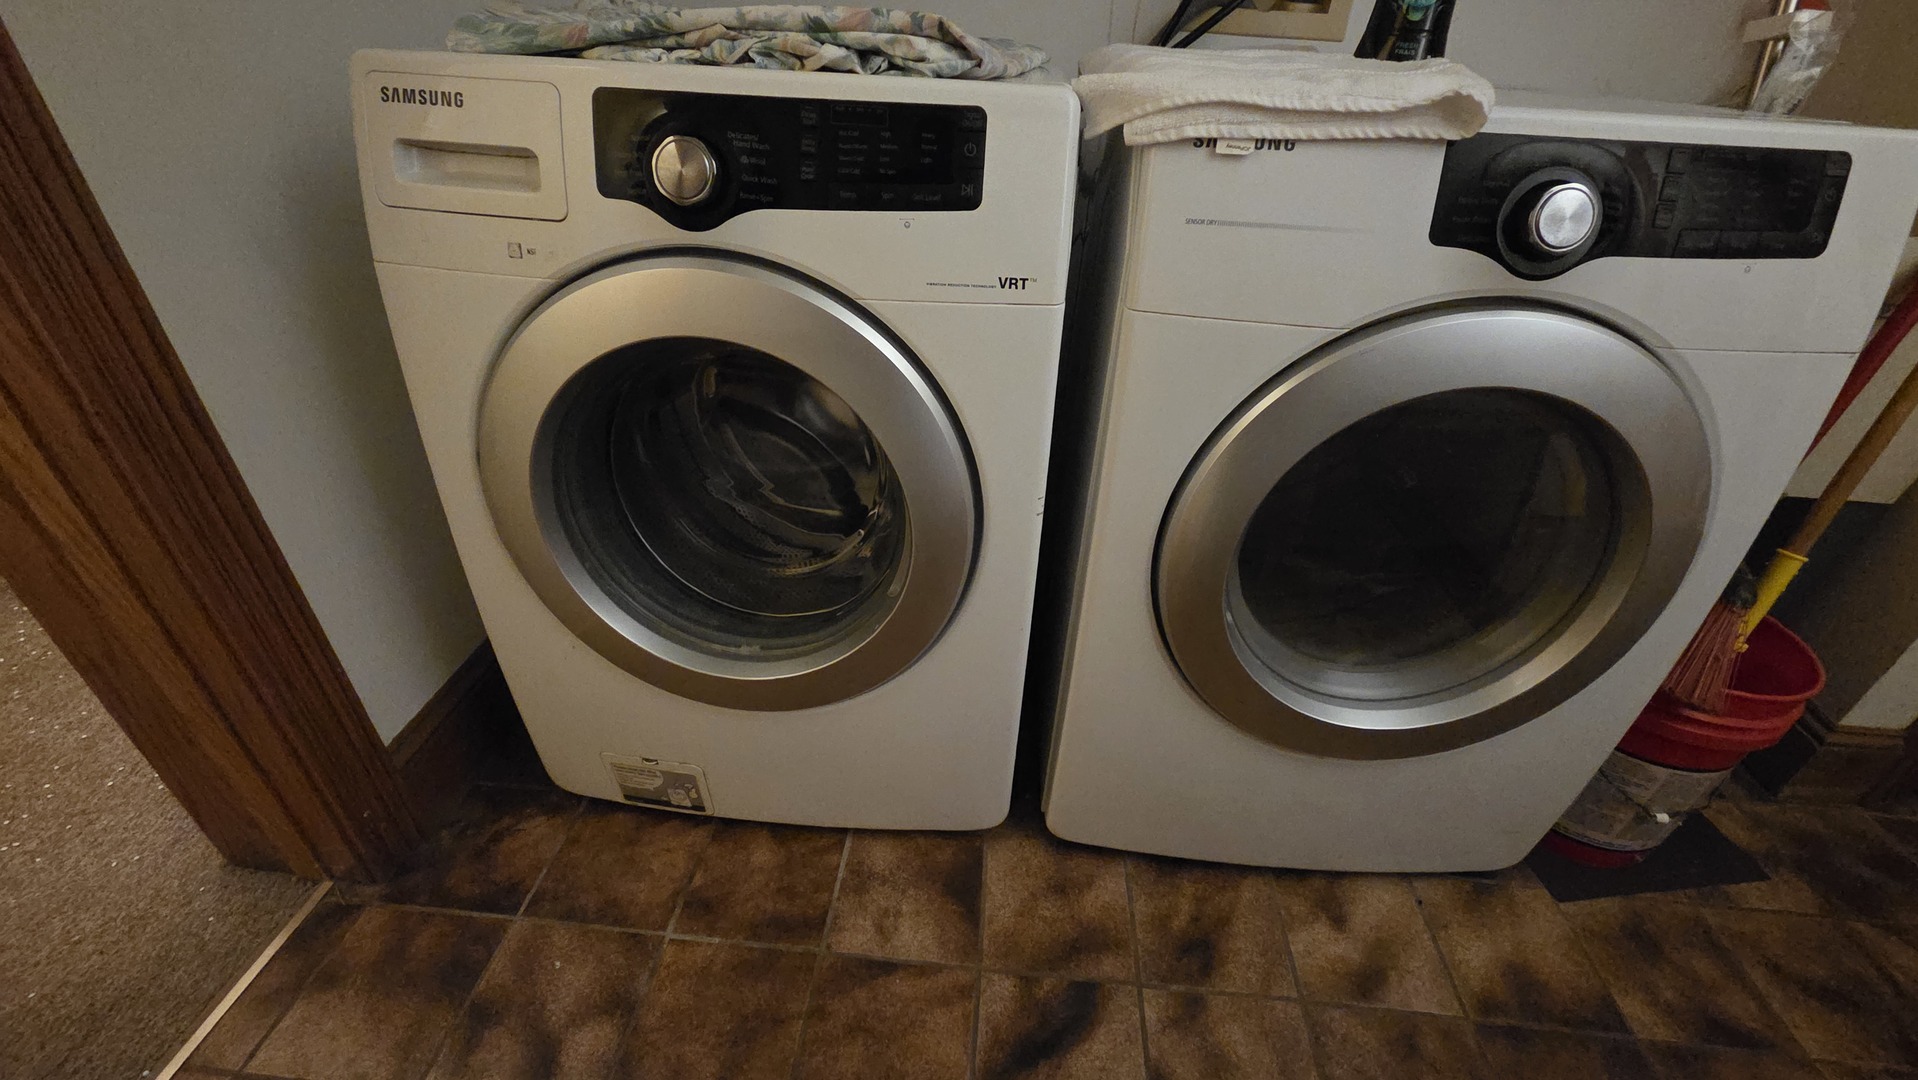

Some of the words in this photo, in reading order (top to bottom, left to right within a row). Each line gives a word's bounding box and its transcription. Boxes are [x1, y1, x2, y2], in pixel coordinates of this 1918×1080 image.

[380, 86, 464, 108] SAMSUNG
[1193, 138, 1296, 152] SAUNG
[1185, 217, 1205, 226] SENSOR
